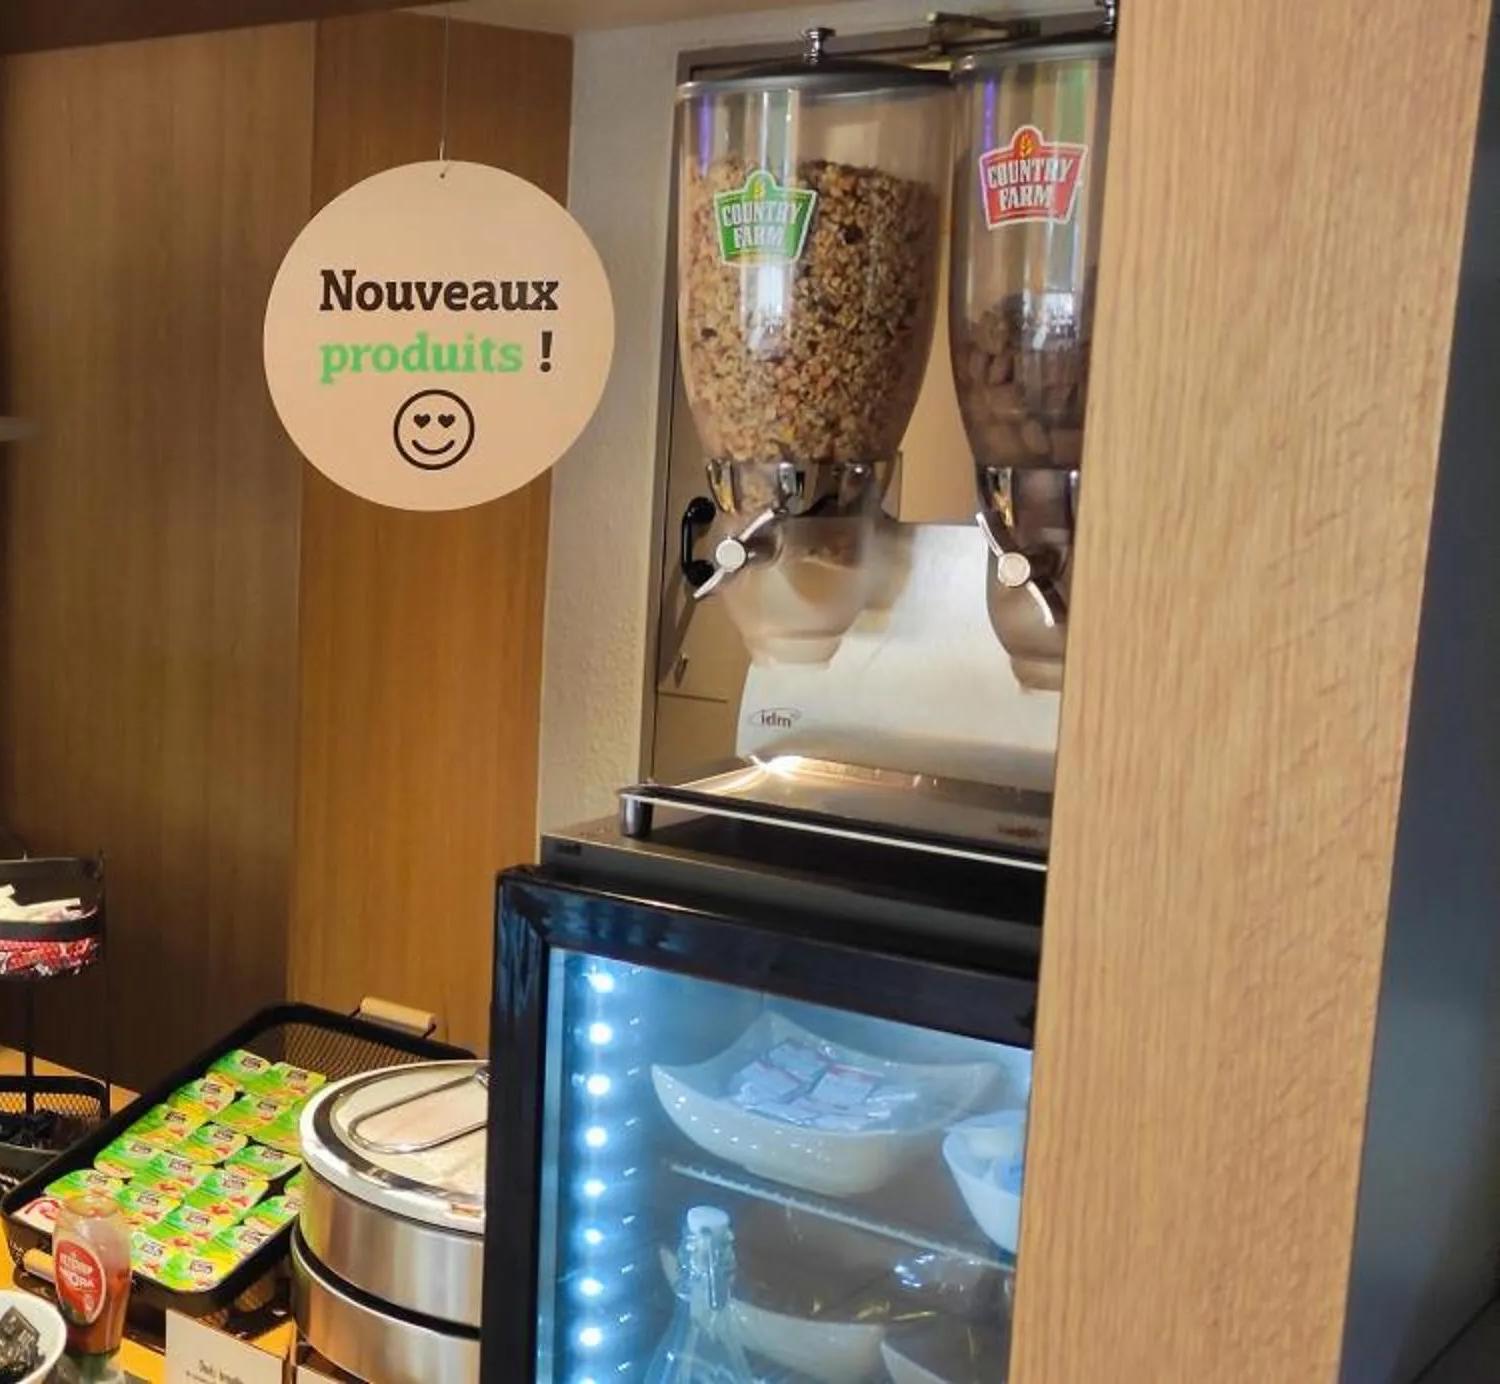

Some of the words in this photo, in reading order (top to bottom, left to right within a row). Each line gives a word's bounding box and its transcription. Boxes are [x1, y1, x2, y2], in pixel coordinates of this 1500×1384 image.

[988, 156, 1074, 189] COUNTRY
[1000, 183, 1055, 212] FARM
[722, 201, 803, 227] COUNTRY
[734, 225, 786, 249] FARM
[320, 269, 559, 311] Nouveaux
[320, 331, 523, 384] produits
[540, 331, 553, 373] !
